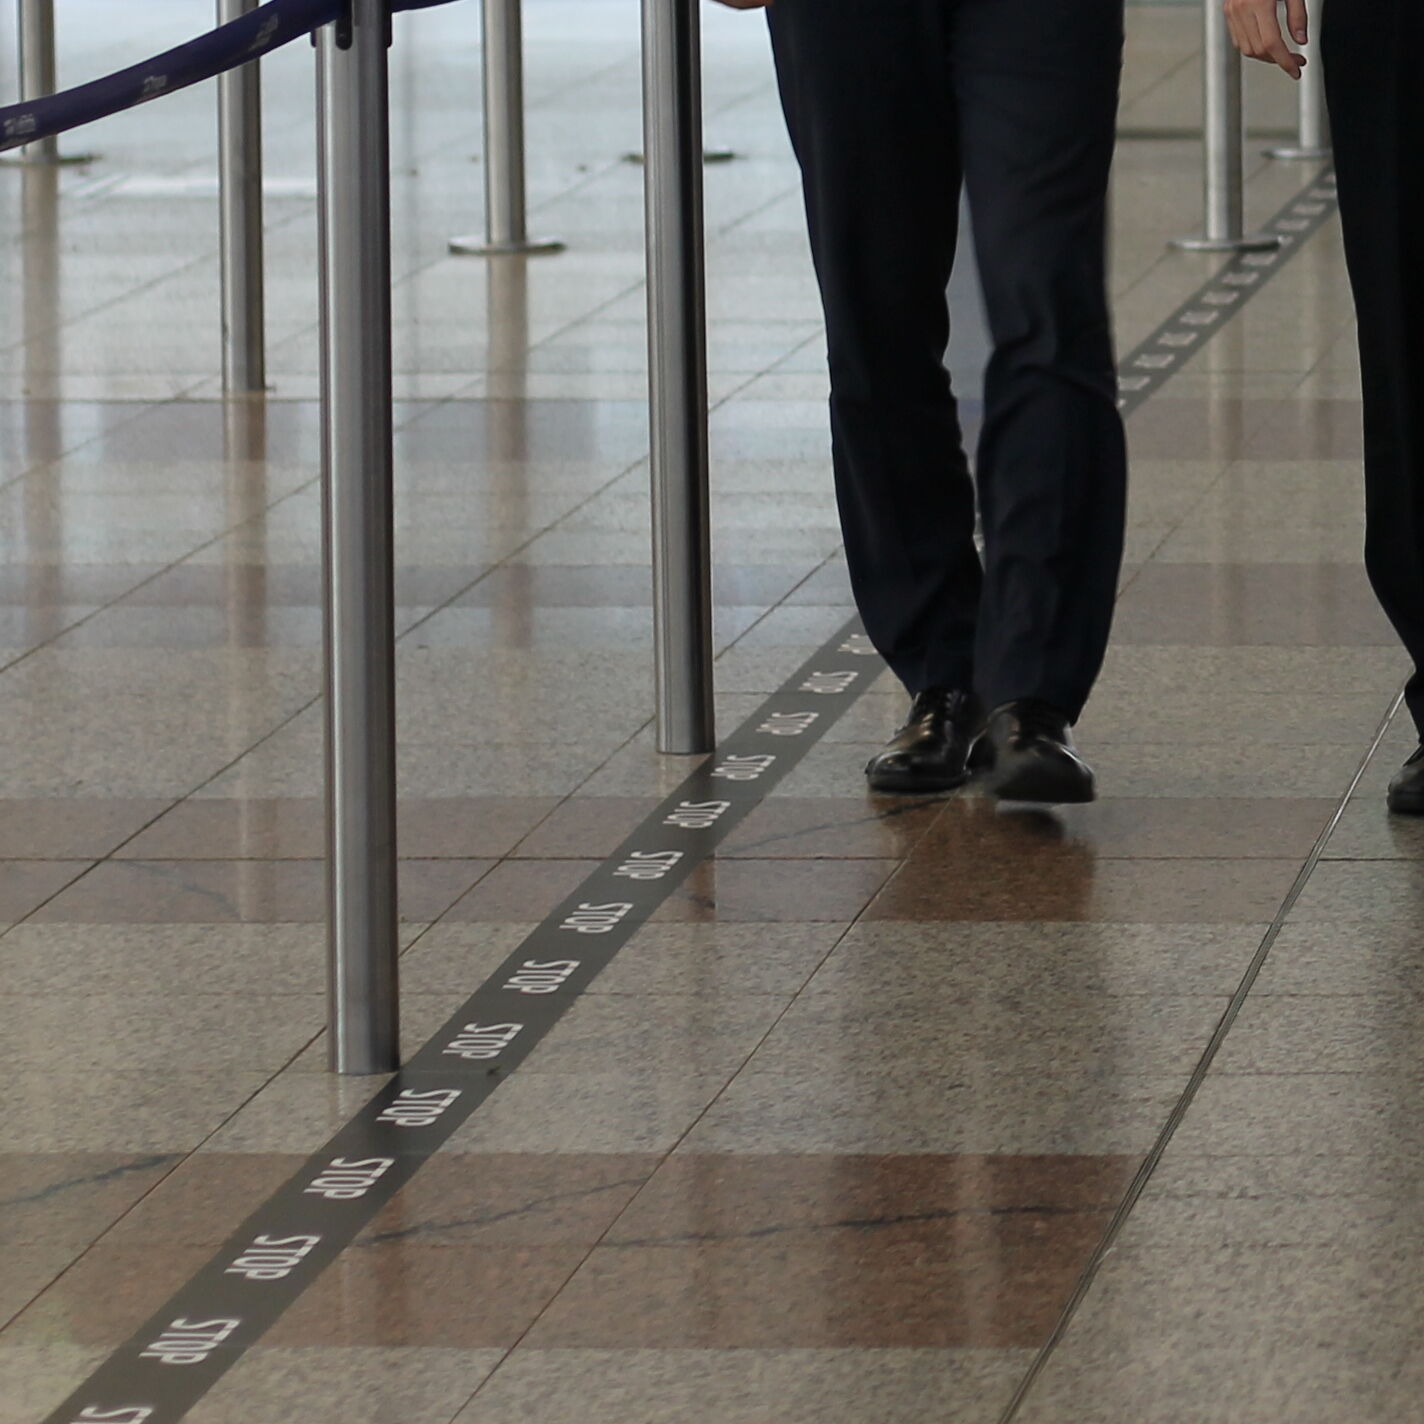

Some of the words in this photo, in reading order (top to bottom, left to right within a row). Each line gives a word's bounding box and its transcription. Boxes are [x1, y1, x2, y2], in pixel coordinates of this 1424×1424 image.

[711, 753, 776, 781] STOP
[662, 800, 731, 829] STOP
[613, 850, 683, 880] STOP
[560, 902, 633, 933] STOP
[503, 959, 580, 993] STOP
[443, 1024, 524, 1058] STOP
[376, 1089, 462, 1126] STOP
[304, 1157, 394, 1200] STOP
[224, 1235, 321, 1280] STOP
[139, 1318, 241, 1364] STOP
